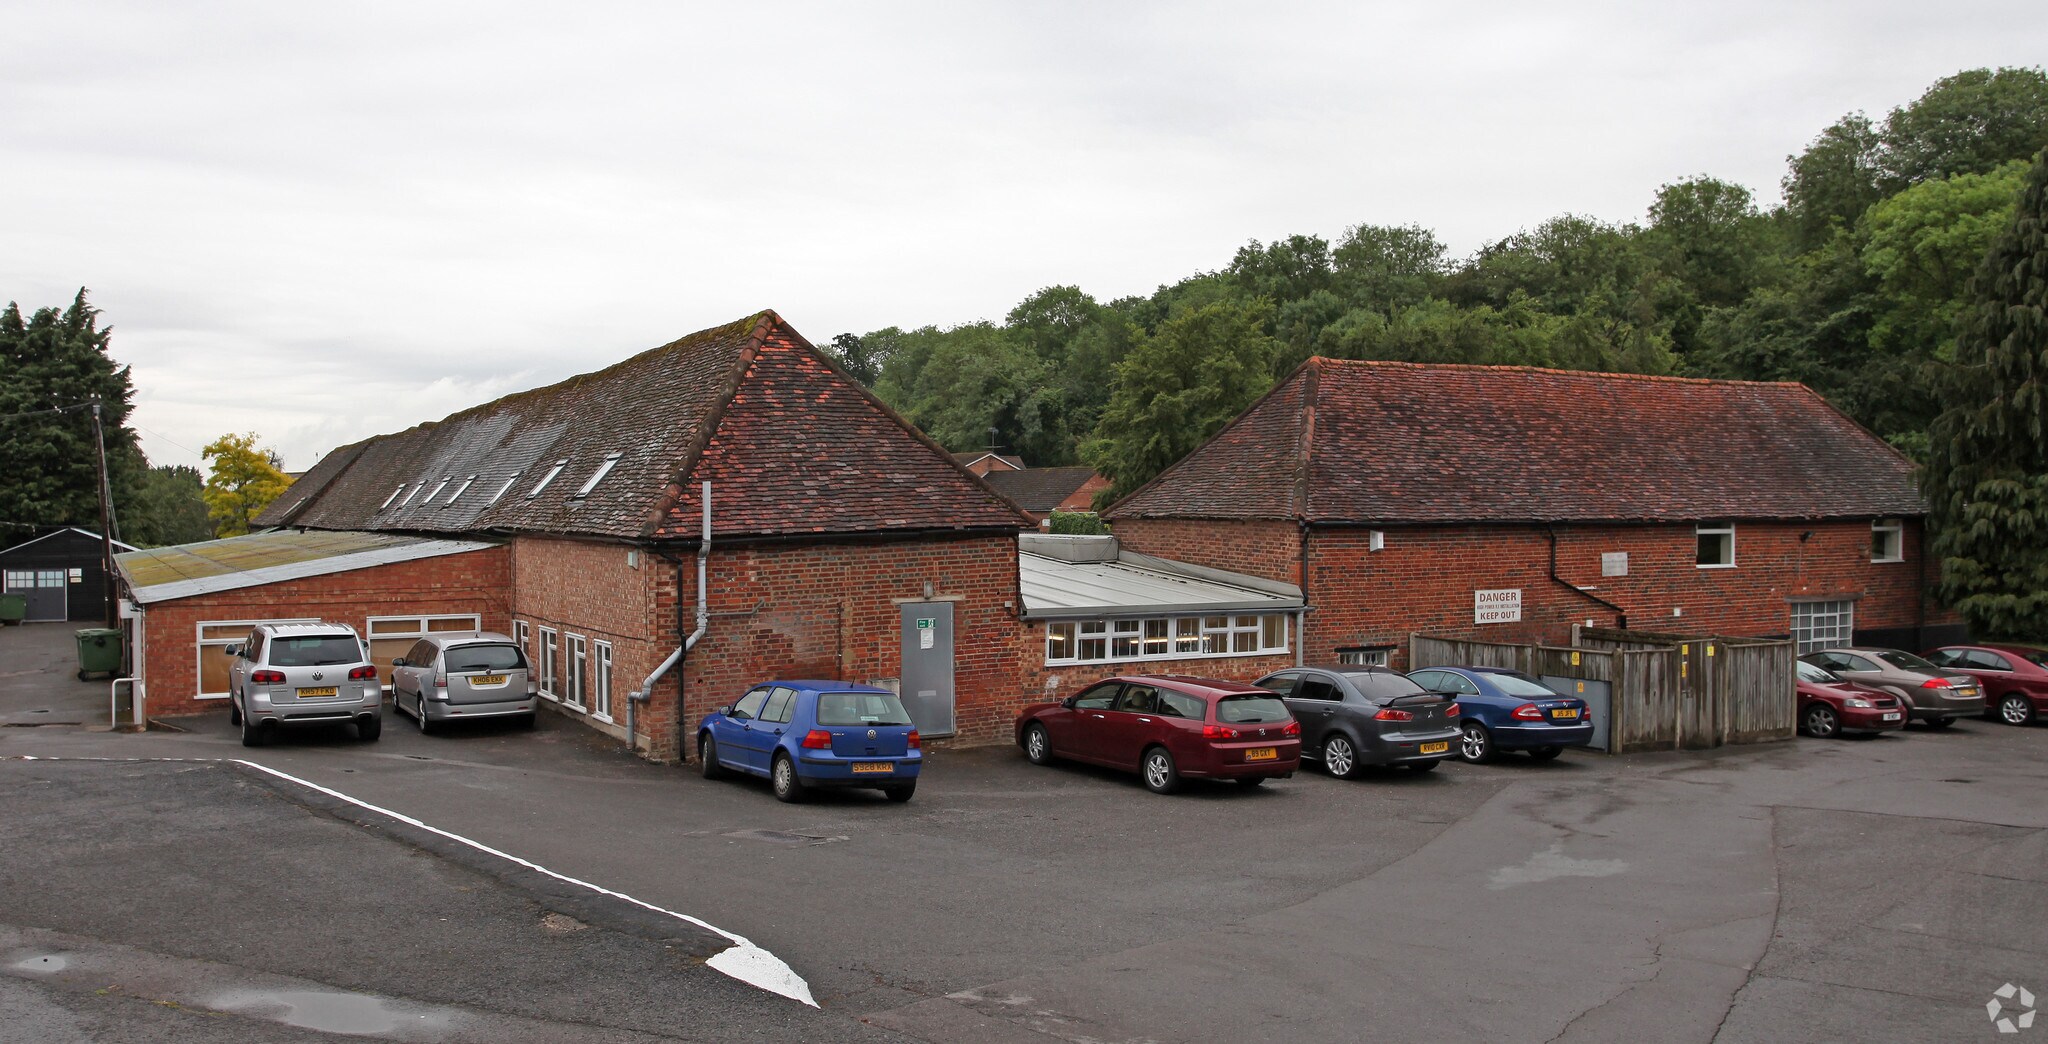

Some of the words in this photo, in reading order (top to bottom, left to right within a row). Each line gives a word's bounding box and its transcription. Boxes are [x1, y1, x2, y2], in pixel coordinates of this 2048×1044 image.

[1479, 592, 1517, 602] DANGER
[1480, 611, 1499, 620] KEEP
[1500, 611, 1516, 619] OUT
[301, 688, 319, 696] KH57
[853, 763, 875, 771] S928
[876, 762, 893, 771] KRX
